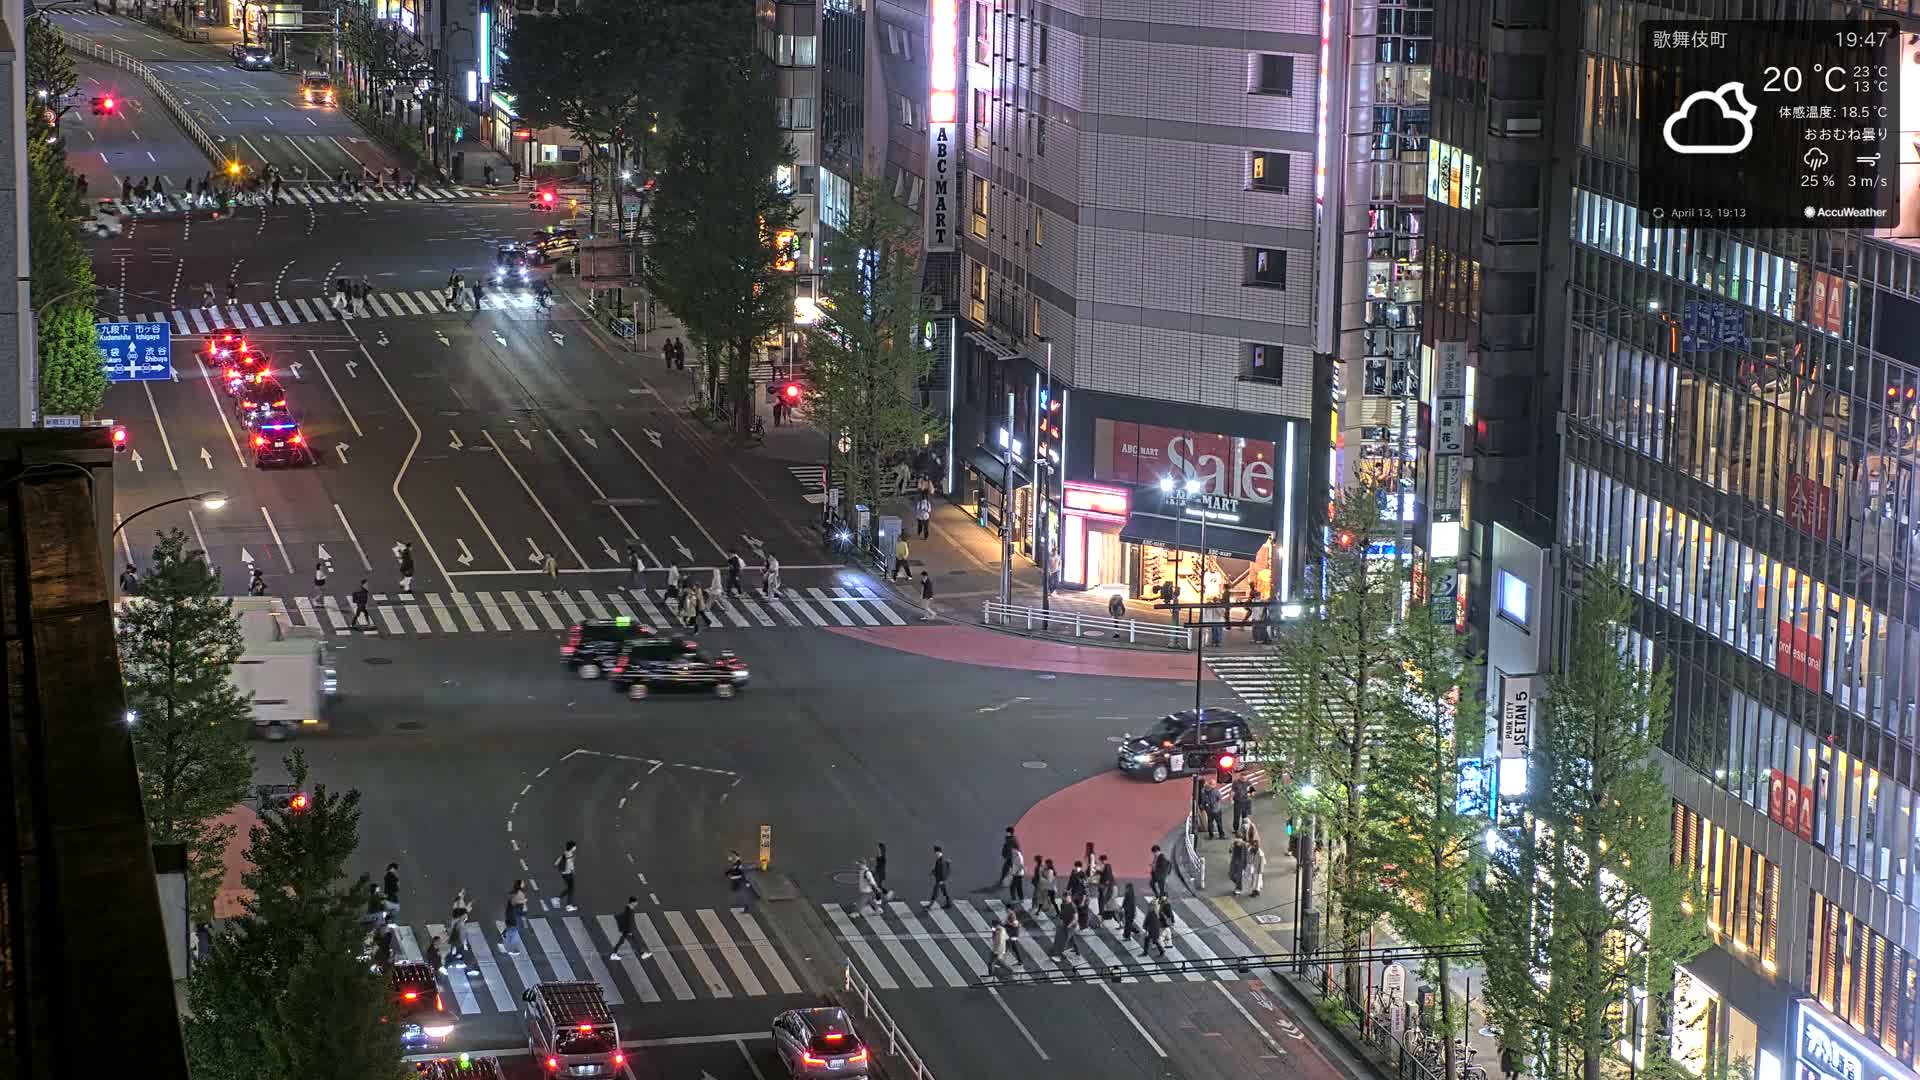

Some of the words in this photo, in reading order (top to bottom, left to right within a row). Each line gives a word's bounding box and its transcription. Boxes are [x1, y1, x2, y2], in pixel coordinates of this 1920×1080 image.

[102, 325, 129, 334] 九段下
[145, 347, 167, 356] 渋谷
[1167, 436, 1273, 504] Sale
[1440, 514, 1452, 522] 7F
[1778, 640, 1823, 671] professional
[1515, 691, 1528, 701] 5
[1506, 701, 1514, 719] CITY
[1505, 720, 1513, 739] PARK
[1514, 704, 1527, 745] ISETAN
[1772, 779, 1811, 825] CPA
